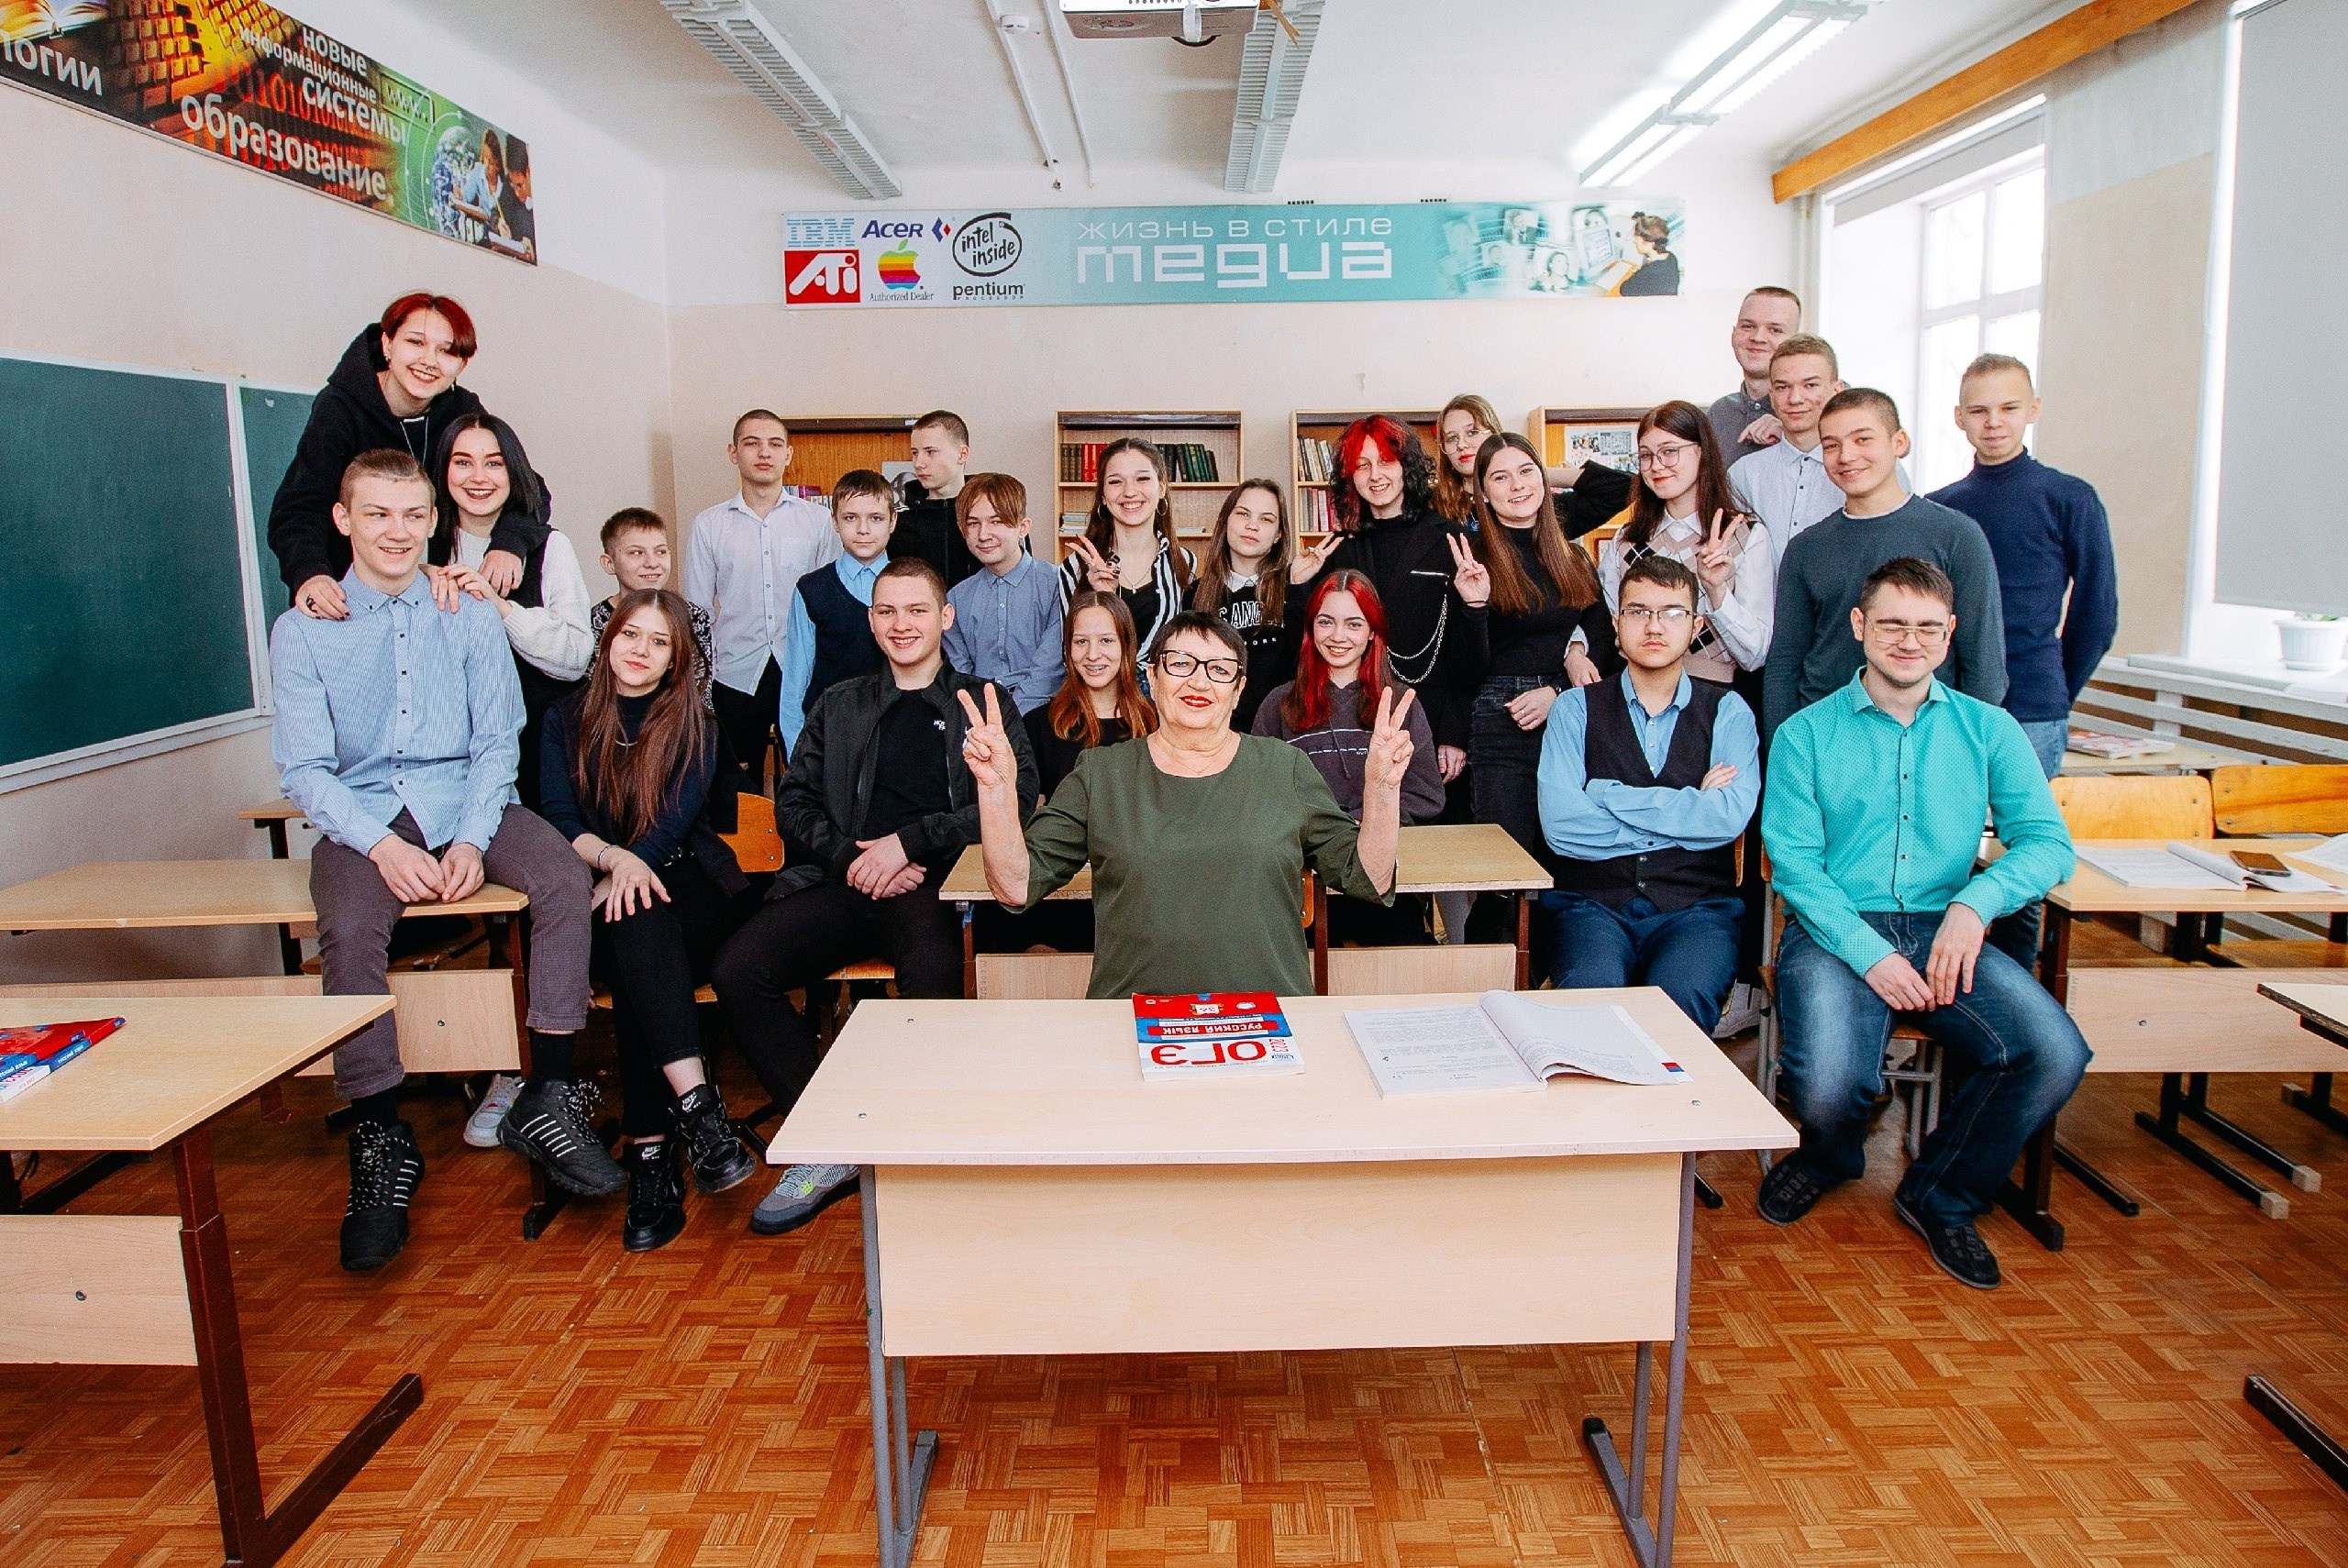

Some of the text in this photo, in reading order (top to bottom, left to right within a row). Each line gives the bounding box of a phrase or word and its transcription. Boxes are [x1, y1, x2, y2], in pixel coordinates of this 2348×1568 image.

[239, 25, 377, 105] информационные
[303, 26, 367, 77] новые
[303, 77, 406, 147] системы
[181, 93, 387, 201] образование
[787, 217, 856, 248] IBM
[961, 221, 993, 253] intel
[972, 238, 1015, 268] inside
[869, 291, 935, 302] Authorized Dealer
[953, 282, 1024, 300] pentium
[1163, 1026, 1200, 1035] ЯЗЫК
[1204, 1022, 1263, 1033] РУССКИЙ
[1150, 1041, 1267, 1066] ОГЭ
